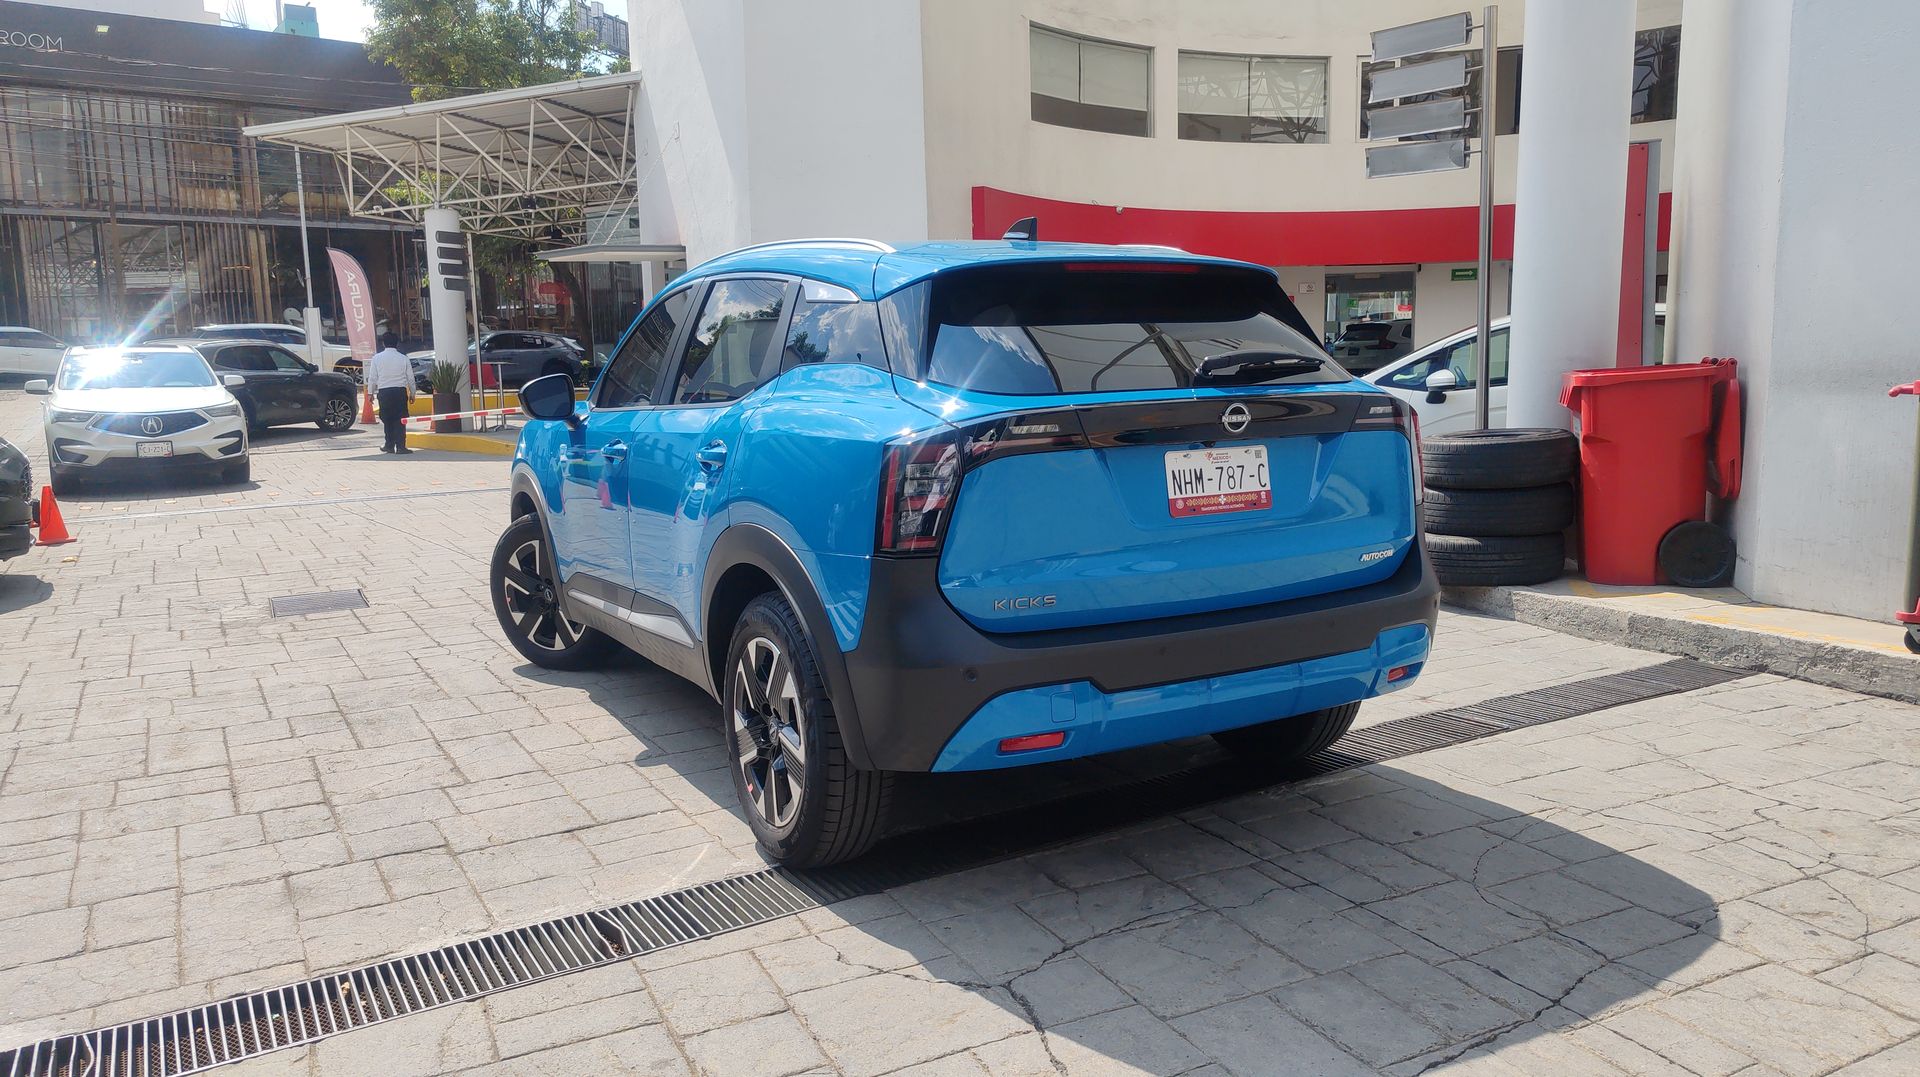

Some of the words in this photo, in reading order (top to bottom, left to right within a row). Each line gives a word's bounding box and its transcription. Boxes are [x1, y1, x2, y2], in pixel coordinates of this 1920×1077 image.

[1222, 414, 1251, 423] NISSAN
[1171, 463, 1267, 496] NHM-787-C
[994, 595, 1057, 611] KICKS
